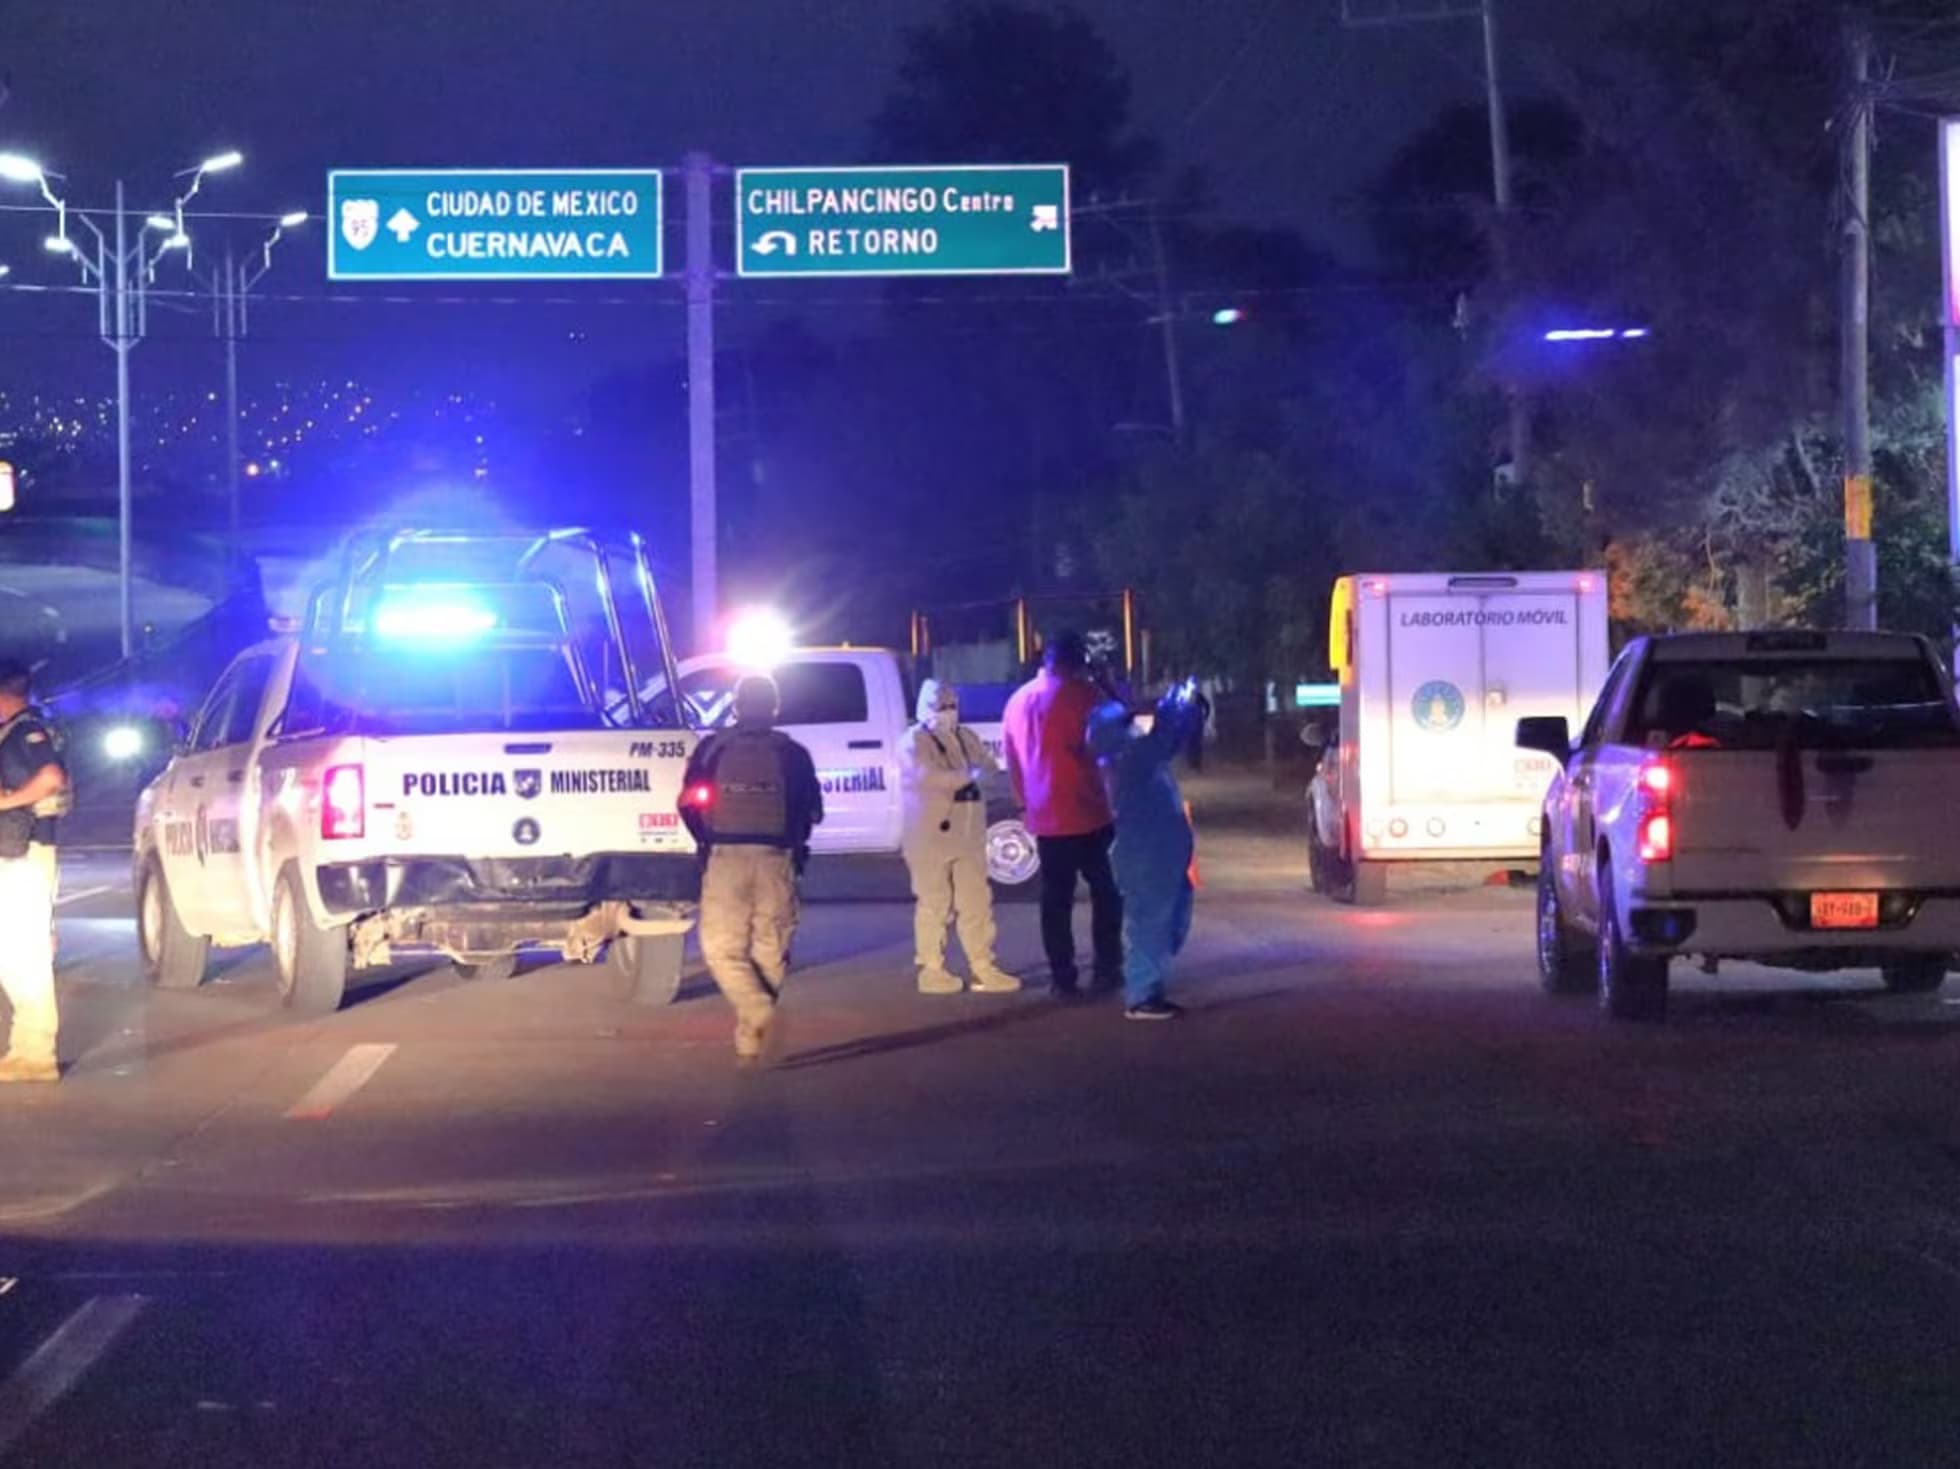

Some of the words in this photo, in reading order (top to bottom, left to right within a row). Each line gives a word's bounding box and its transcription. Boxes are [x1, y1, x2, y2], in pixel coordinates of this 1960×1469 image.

[426, 191, 511, 216] CIUDAD
[516, 191, 545, 216] DE
[552, 190, 638, 216] MEXICO
[748, 187, 937, 215] CHILPANCINGO
[943, 187, 1014, 213] Centro
[426, 231, 630, 258] CUERNAVACA
[809, 228, 938, 255] RETORNO
[1400, 610, 1514, 627] LABORATORIO
[629, 741, 686, 759] PM-335
[402, 772, 507, 796] POLICIA
[550, 769, 652, 794] MINISTERIAL
